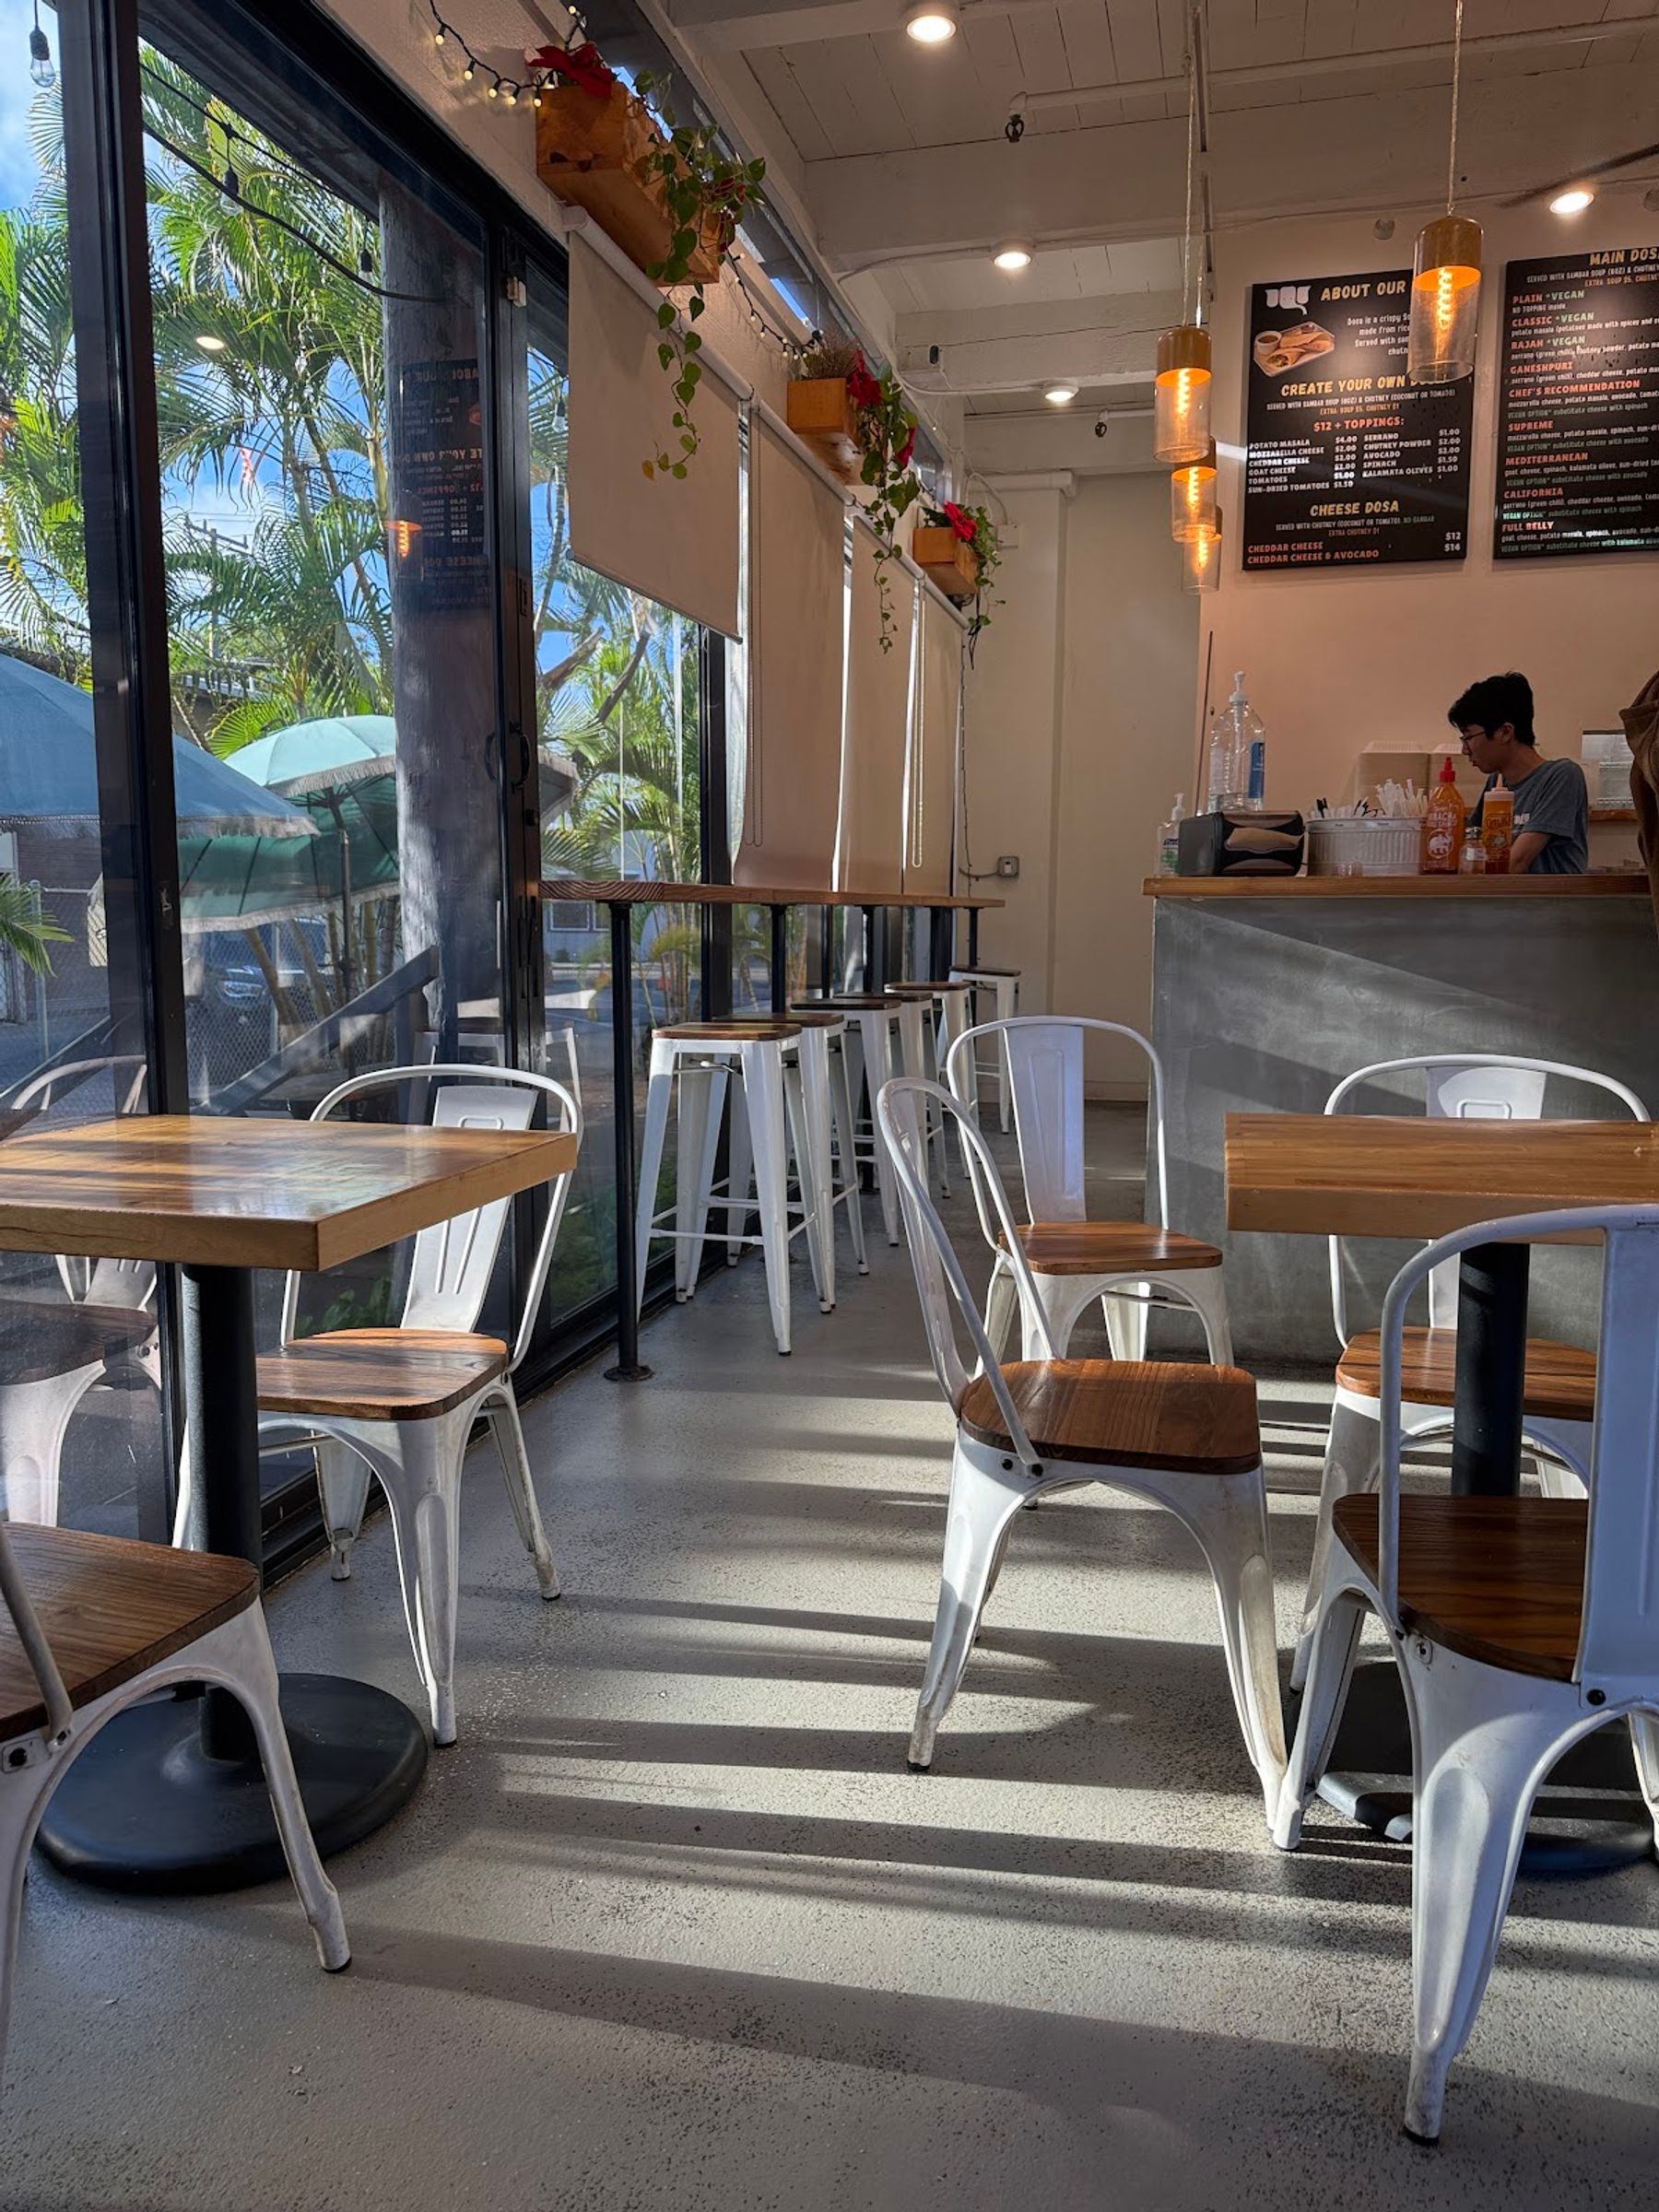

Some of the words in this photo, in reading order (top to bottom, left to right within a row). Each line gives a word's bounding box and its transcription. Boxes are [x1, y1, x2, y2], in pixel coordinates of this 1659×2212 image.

[1590, 251, 1625, 265] MAIN
[1630, 247, 1659, 262] DOS
[1321, 284, 1371, 301] ABOUT
[1377, 280, 1406, 295] OUR
[1512, 293, 1543, 304] PLAIN
[1380, 314, 1401, 323] crispy
[1512, 316, 1552, 327] CLASSIC
[1359, 327, 1377, 335] made
[1355, 339, 1379, 347] Served
[1380, 337, 1395, 346] with
[1388, 347, 1408, 356] chutn
[1510, 361, 1573, 374] GANESHPURI
[1281, 380, 1333, 396] CREATE
[1338, 378, 1371, 393] YOUR
[1378, 375, 1406, 389] OWN
[1509, 387, 1541, 398] CHEF'S
[1544, 380, 1641, 394] RECOMMENDATION
[1313, 422, 1332, 431] $12
[1345, 417, 1405, 429] TOPPINGS:
[1508, 420, 1554, 431] SUPREME
[1249, 441, 1277, 450] POTATO
[1279, 439, 1311, 448] MASALA
[1335, 436, 1357, 444] $4.00
[1364, 433, 1399, 441] SERRANO
[1364, 442, 1397, 451] CHUTNEY
[1399, 439, 1432, 448] POWDER
[1439, 438, 1461, 446] $2.00
[1248, 450, 1298, 459] MOZZARELLA
[1299, 447, 1325, 455] CHEESE
[1335, 444, 1357, 453] $2.00
[1364, 451, 1401, 460] AVOCADO
[1248, 459, 1282, 467] CHEDDAR
[1283, 457, 1310, 465] CHEESE
[1335, 453, 1357, 462] $2.00
[1363, 460, 1396, 468] SPINACH
[1505, 453, 1589, 465] MEDITERRANEAN
[1270, 466, 1296, 475] CHEESE
[1335, 463, 1355, 471] $2.00
[1362, 468, 1405, 477] KALAMATA
[1405, 466, 1433, 475] OLIVES
[1438, 465, 1458, 473] $1.00
[1248, 476, 1288, 485] TOMATOES
[1248, 485, 1288, 494] SUN-DRIED
[1504, 488, 1563, 500] CALIFORNIA
[1310, 503, 1360, 517] CHEESE
[1365, 500, 1399, 514] DOSA
[1502, 524, 1524, 532] FULL
[1525, 522, 1554, 530] BELLY
[1248, 544, 1288, 553] CHEDDAR
[1290, 542, 1324, 551] CHEESE
[1445, 532, 1461, 540] $12
[1248, 555, 1288, 564] CHEDDAR
[1290, 553, 1324, 562] CHEESE
[1335, 549, 1380, 559] AVOCADO
